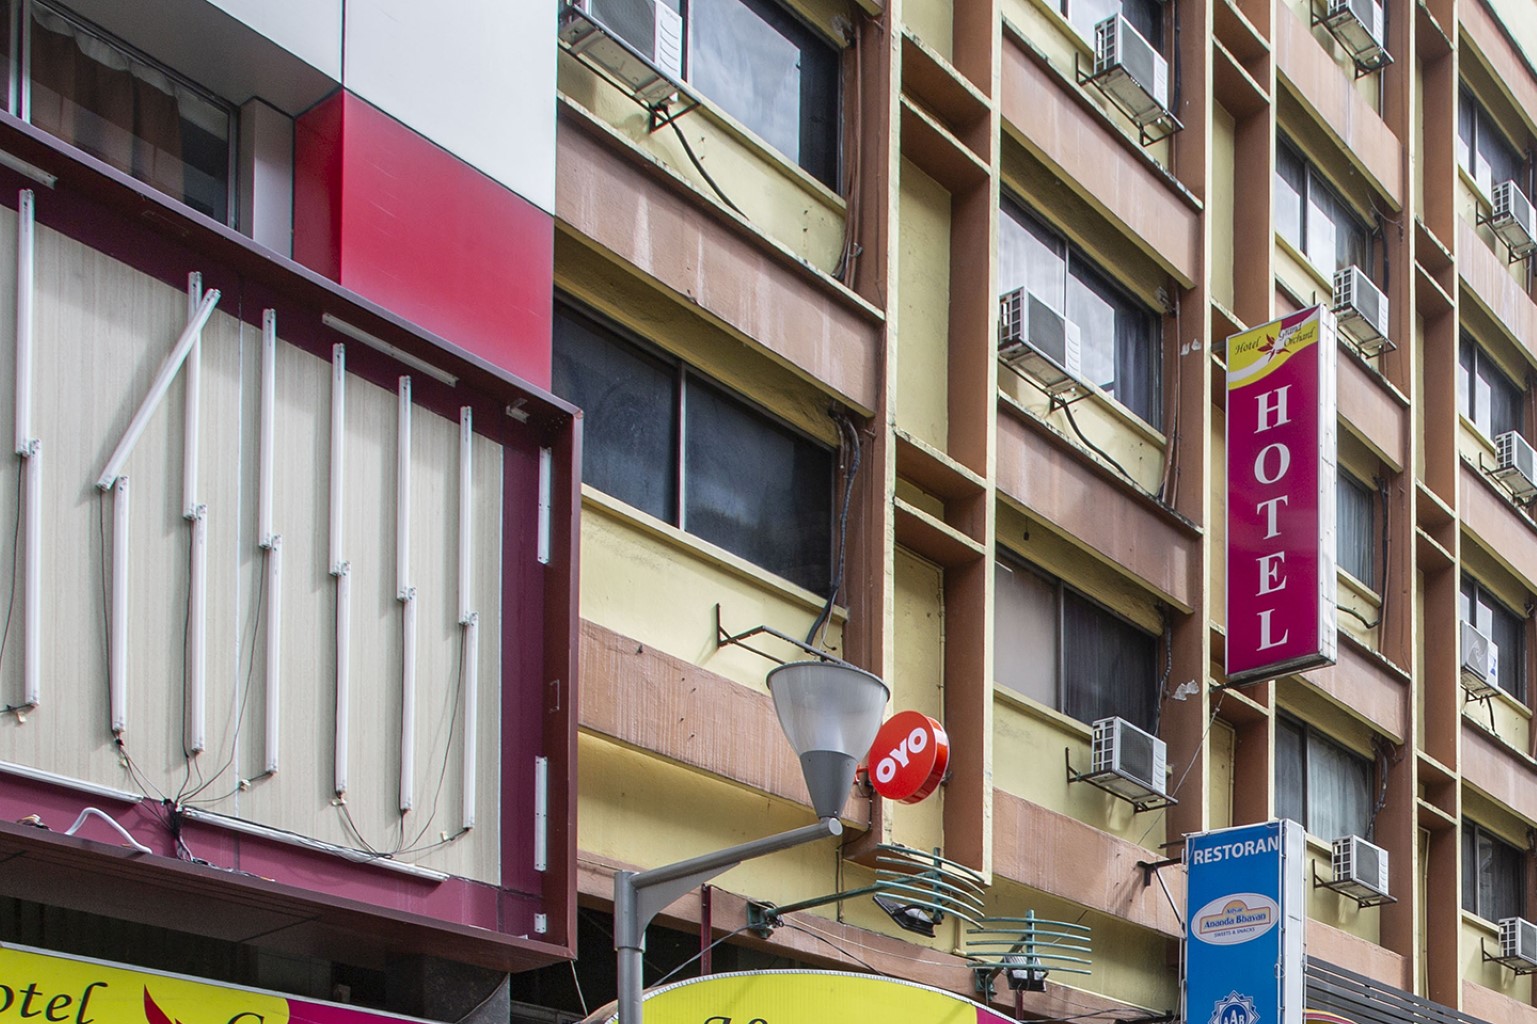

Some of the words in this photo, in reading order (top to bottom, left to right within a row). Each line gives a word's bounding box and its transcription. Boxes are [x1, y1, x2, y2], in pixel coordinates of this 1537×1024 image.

[1235, 336, 1261, 355] Hotel
[1253, 384, 1292, 652] HOTEL
[875, 728, 928, 784] OYO
[1193, 836, 1279, 865] RESTORAN
[1204, 917, 1234, 929] Ananda
[1236, 912, 1266, 924] Bhavan
